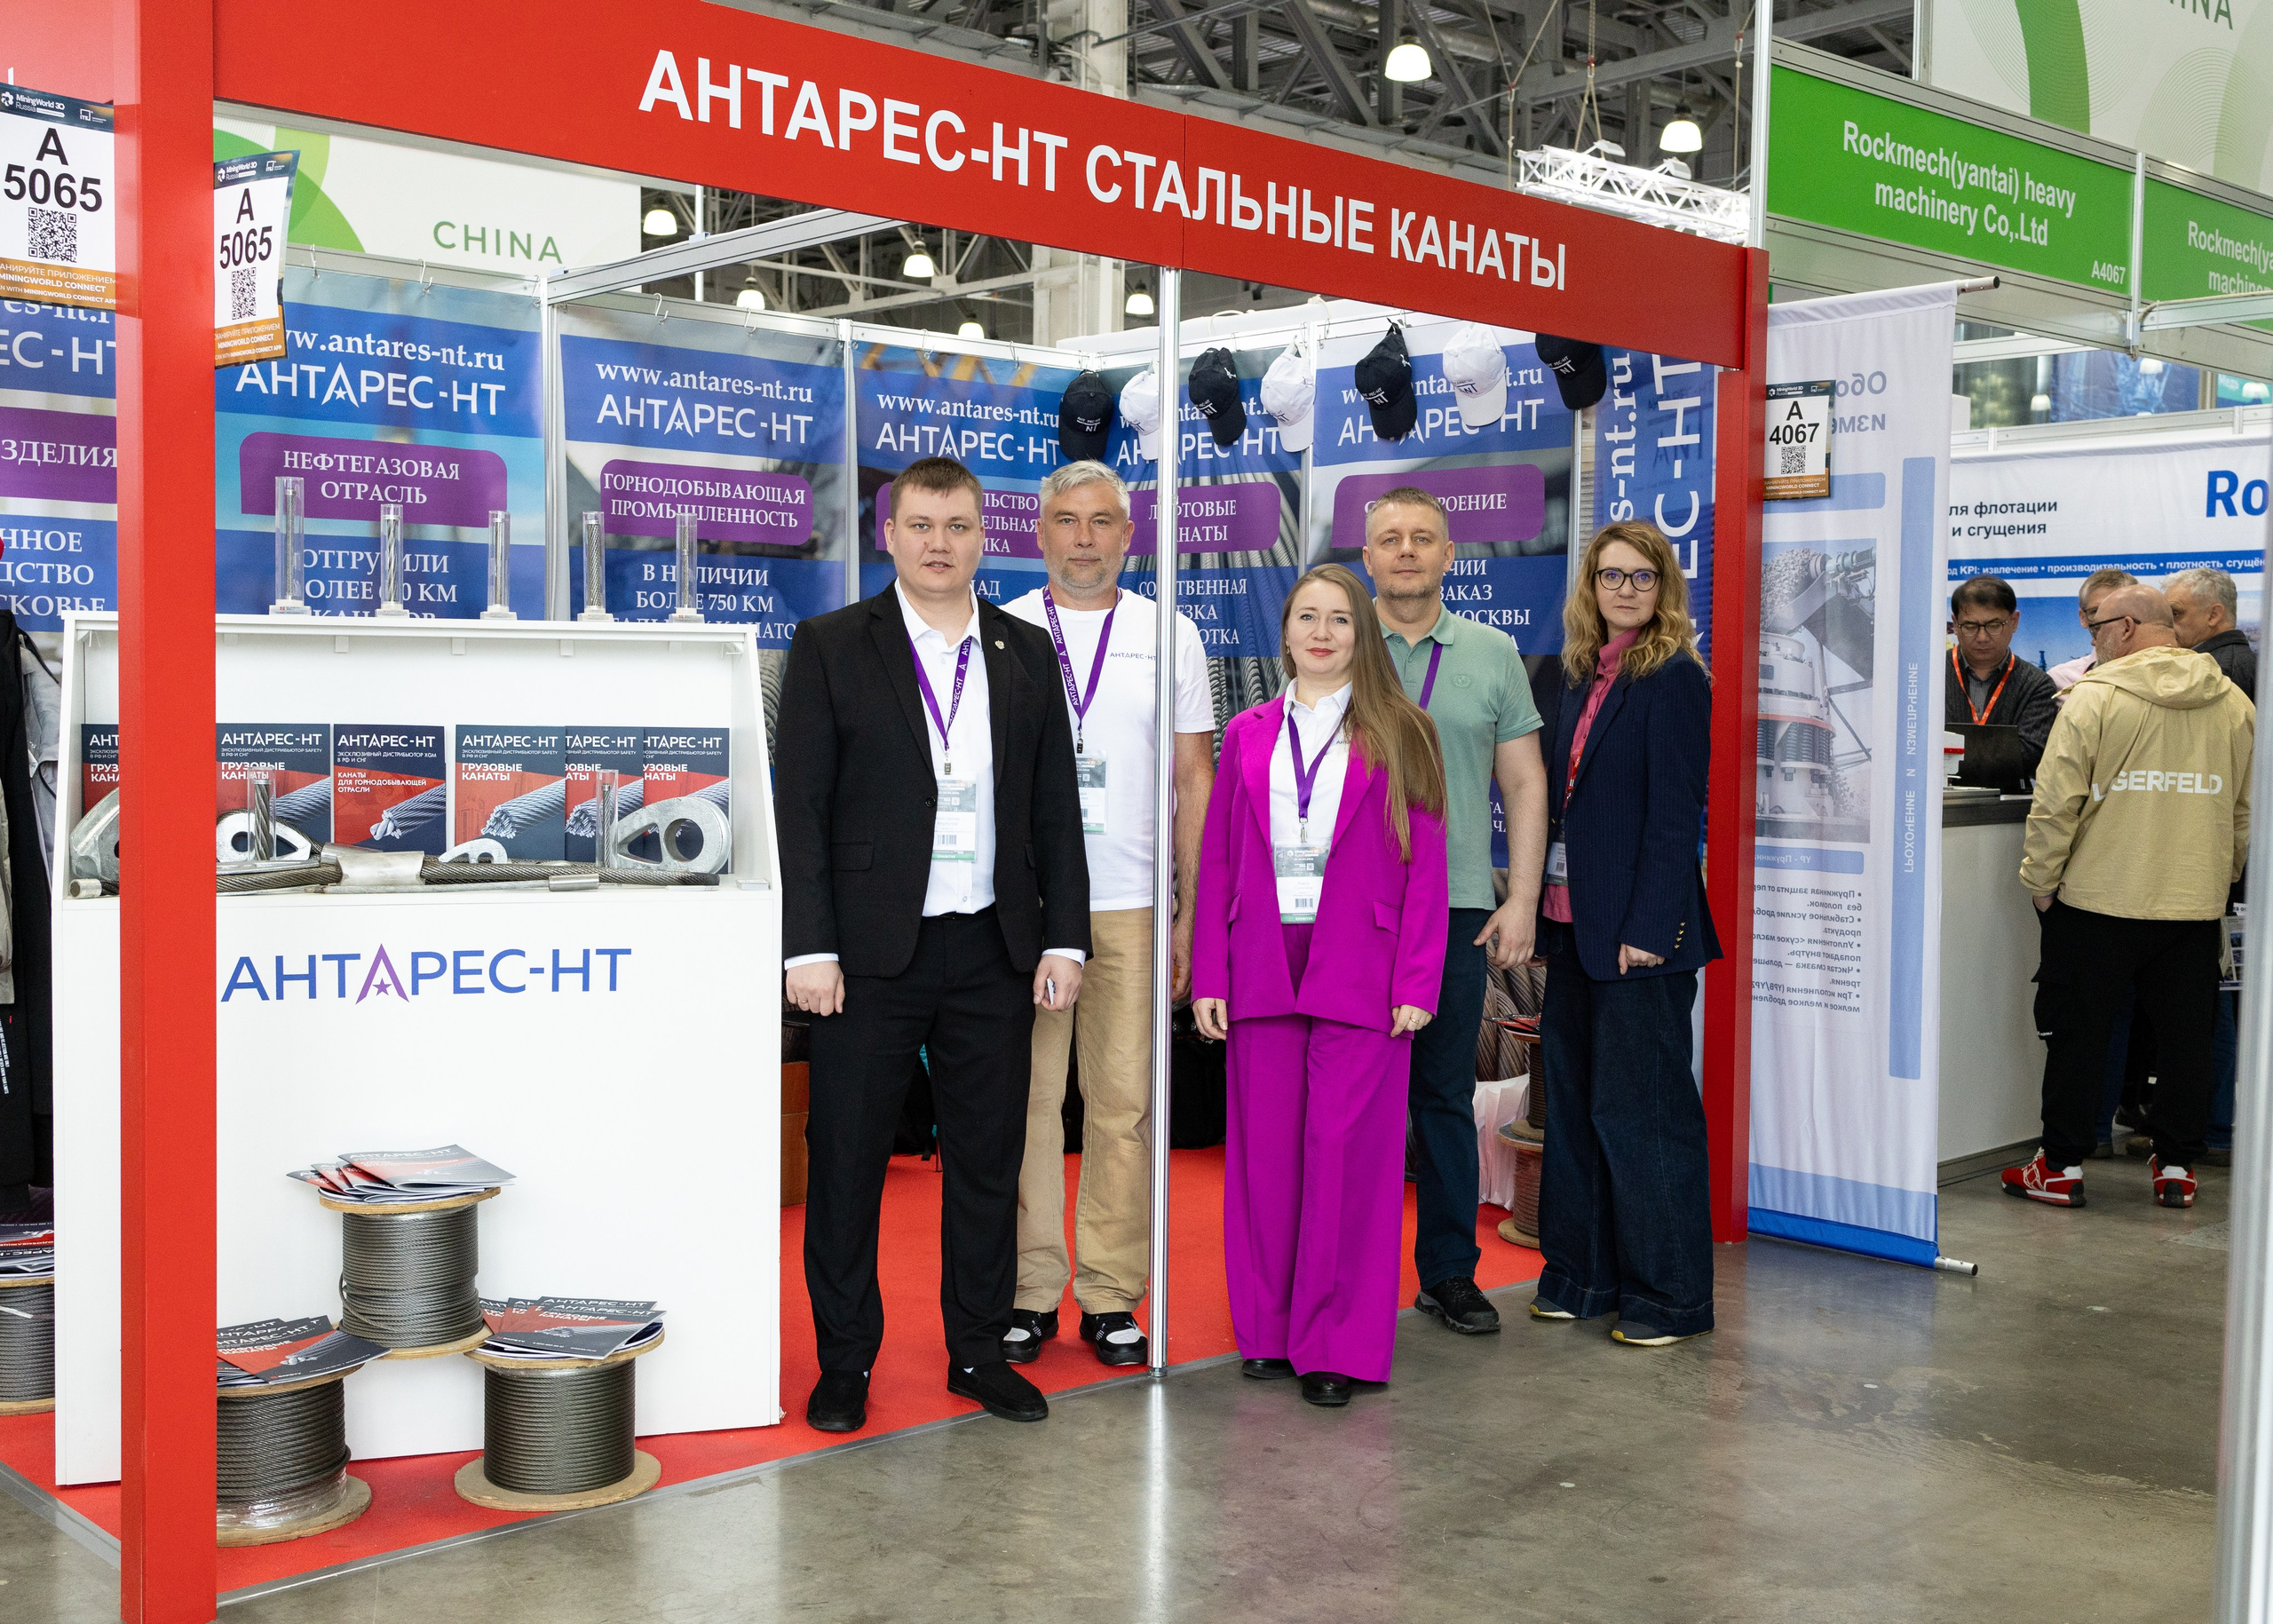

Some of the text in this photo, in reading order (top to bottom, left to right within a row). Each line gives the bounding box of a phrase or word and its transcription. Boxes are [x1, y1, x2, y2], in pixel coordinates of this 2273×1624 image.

[16, 93, 54, 108] MiningWorld
[638, 49, 1565, 291] АНТАРЕС-НТ СТАЛЬНЫЕ КАНАТЫ
[1842, 120, 2077, 218] Rockmech(yantai) heavy
[4, 163, 103, 213] 5065
[1875, 181, 2048, 248] machinery Co,.Ltd
[219, 226, 273, 269] 5065
[432, 220, 563, 265] CHINA
[0, 273, 107, 293] MININGWORLD CONNECT
[47, 269, 116, 284] ПРИЛОЖЕНИЕМ
[2092, 259, 2126, 286] A4067
[23, 288, 72, 299] MININGWORLD
[73, 294, 104, 303] CONNECT
[250, 333, 274, 345] CONNECT
[235, 360, 506, 416] АНТАРЕС-НТ
[595, 362, 814, 404] www.antares-nt.ru
[596, 393, 814, 445] АНТАРЕС-НТ
[876, 393, 1060, 429] www.antares-nt.ru
[875, 421, 1060, 465] АНТАРЕС-НТ
[1769, 423, 1820, 445] 4067
[283, 450, 460, 480] НЕФТЕГАЗОВАЯ
[321, 480, 428, 504] ОТРАСЛЬ
[603, 472, 805, 506] ГОРНОДОБЫВАЮЩАЯ
[1974, 500, 2058, 523] флотации
[1176, 525, 1228, 543] НАТЫ
[1952, 522, 2047, 540] и сгущения
[642, 564, 769, 587] В НЛИЧИИ
[1982, 565, 2039, 575] извлечение
[2166, 558, 2224, 571] плотность
[419, 583, 457, 603] КМ
[708, 593, 737, 613] 750
[741, 595, 774, 614] КМ
[221, 732, 322, 747] АНТАРЕС-НТ
[337, 733, 435, 749] АНТАРЕС-НТ
[462, 733, 558, 749] АНТАРЕС-НТ
[221, 762, 286, 772] ГРУЗОВЫЕ
[462, 763, 523, 772] ГРУЗОВЫЕ
[462, 772, 511, 781] КАНАТЫ
[643, 772, 676, 781] НАТЫ
[354, 778, 427, 787] ГОРНОДОБЫВАЮЩЕЙ
[2092, 769, 2223, 803] LGERFELD
[219, 942, 632, 1006] АНТАРЕС-НТ
[553, 1304, 656, 1316] АНТАРЕС-НТ
